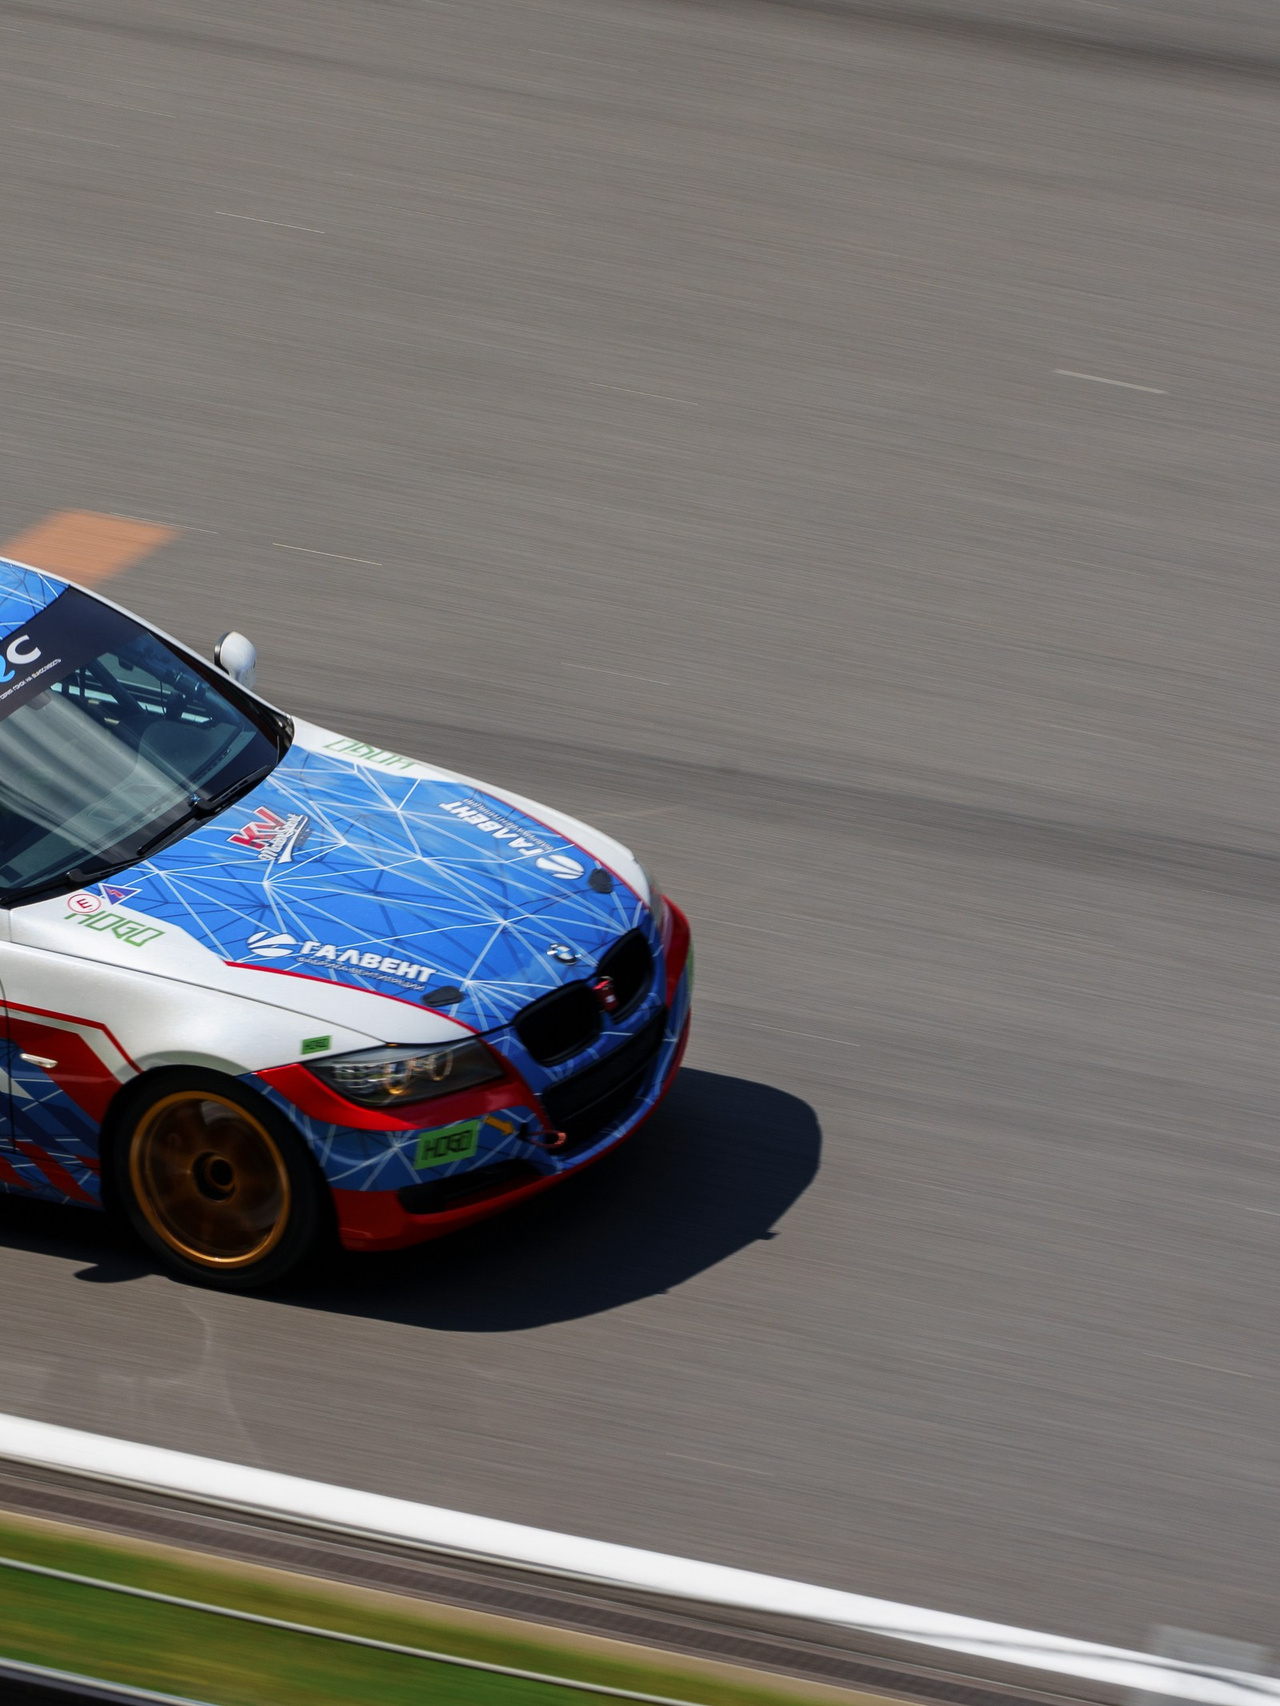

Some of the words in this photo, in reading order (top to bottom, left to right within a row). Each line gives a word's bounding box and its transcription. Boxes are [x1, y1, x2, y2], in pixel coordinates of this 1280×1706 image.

[226, 806, 287, 851] KV
[438, 801, 544, 856] ГАЛВЕНТ
[63, 910, 166, 947] HOGO
[300, 940, 437, 983] ГАЛВЕНТ
